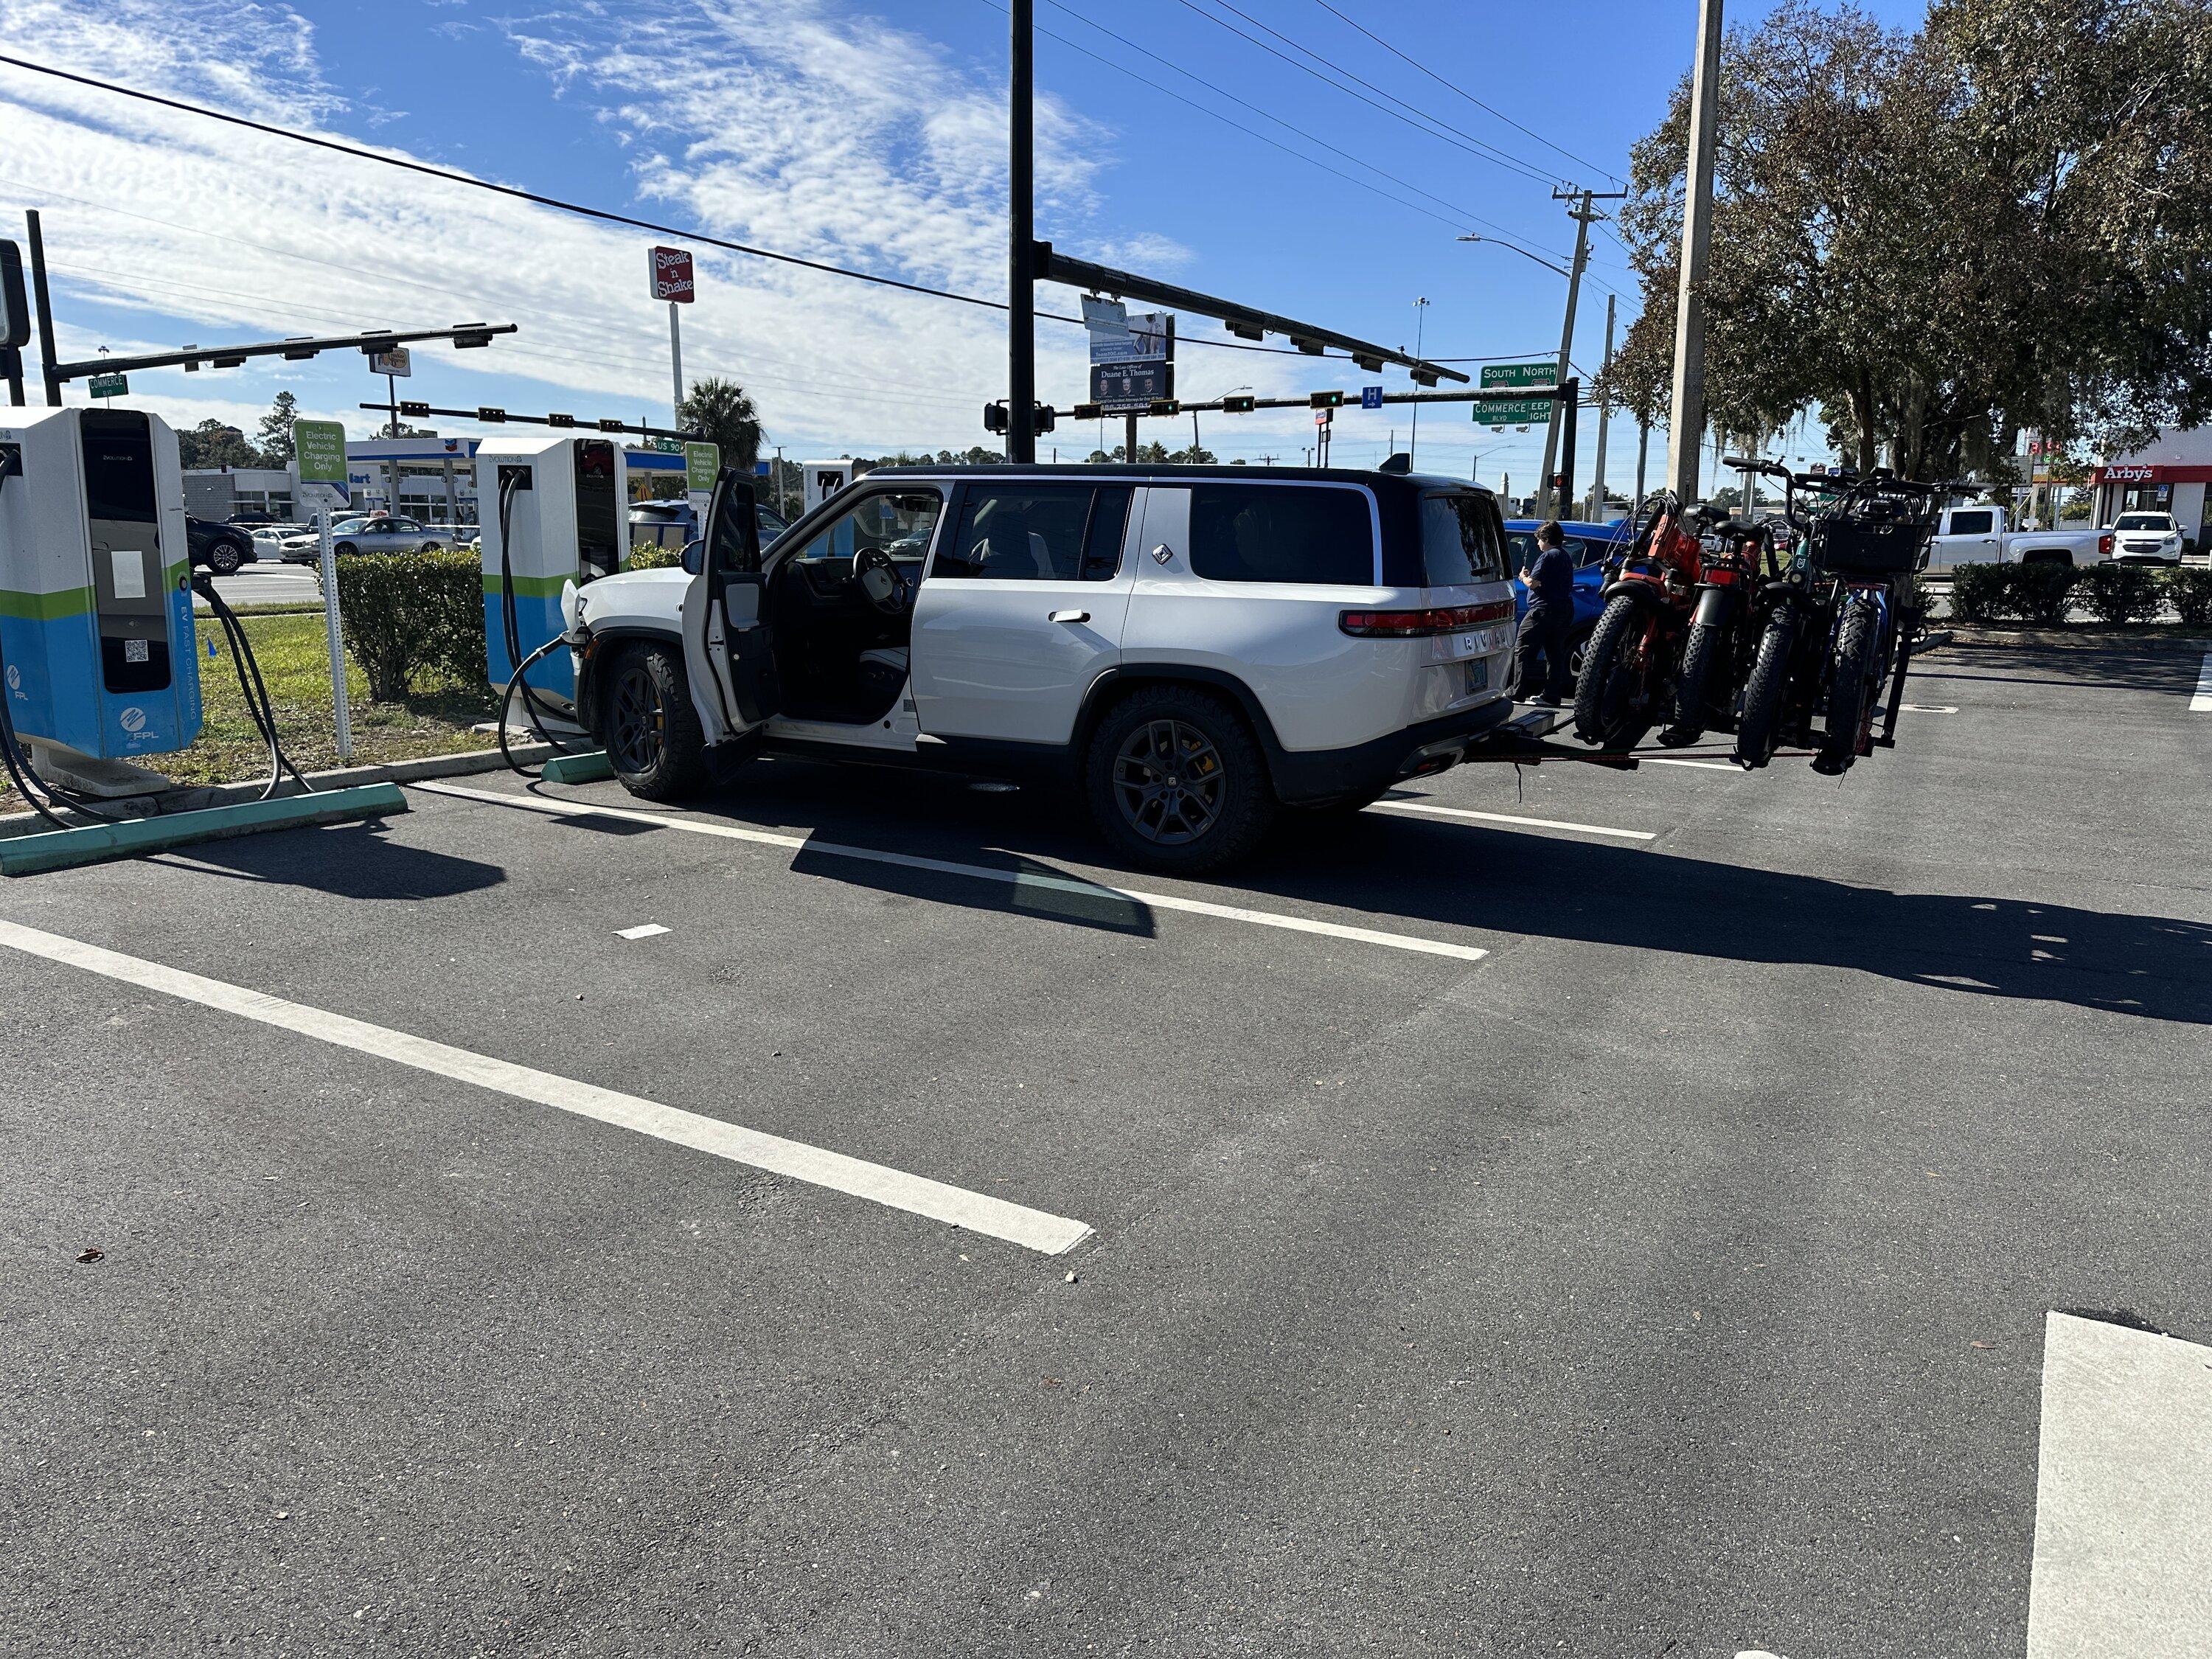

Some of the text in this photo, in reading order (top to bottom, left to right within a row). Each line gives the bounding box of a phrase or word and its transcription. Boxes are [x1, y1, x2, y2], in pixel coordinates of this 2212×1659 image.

[655, 251, 690, 269] Steak
[658, 279, 694, 297] Shake
[1484, 366, 1556, 378] SOUTH NORTH
[89, 376, 122, 389] COMMERCE
[1368, 388, 1377, 400] H
[1475, 403, 1526, 413] COMMERCE
[1529, 402, 1551, 410] EEP
[1529, 412, 1551, 420] IGHT
[305, 431, 337, 440] Electric
[307, 442, 335, 451] Vehicle
[658, 442, 680, 451] US 90
[304, 451, 341, 462] Charging
[314, 462, 333, 472] Only
[691, 466, 715, 476] Charging
[2104, 466, 2153, 482] Arby's
[698, 475, 710, 484] Only
[1464, 630, 1506, 650] RIVIAN
[181, 606, 197, 720] EV FAST CHARGING
[15, 691, 28, 700] FPL
[133, 731, 159, 740] FPL
